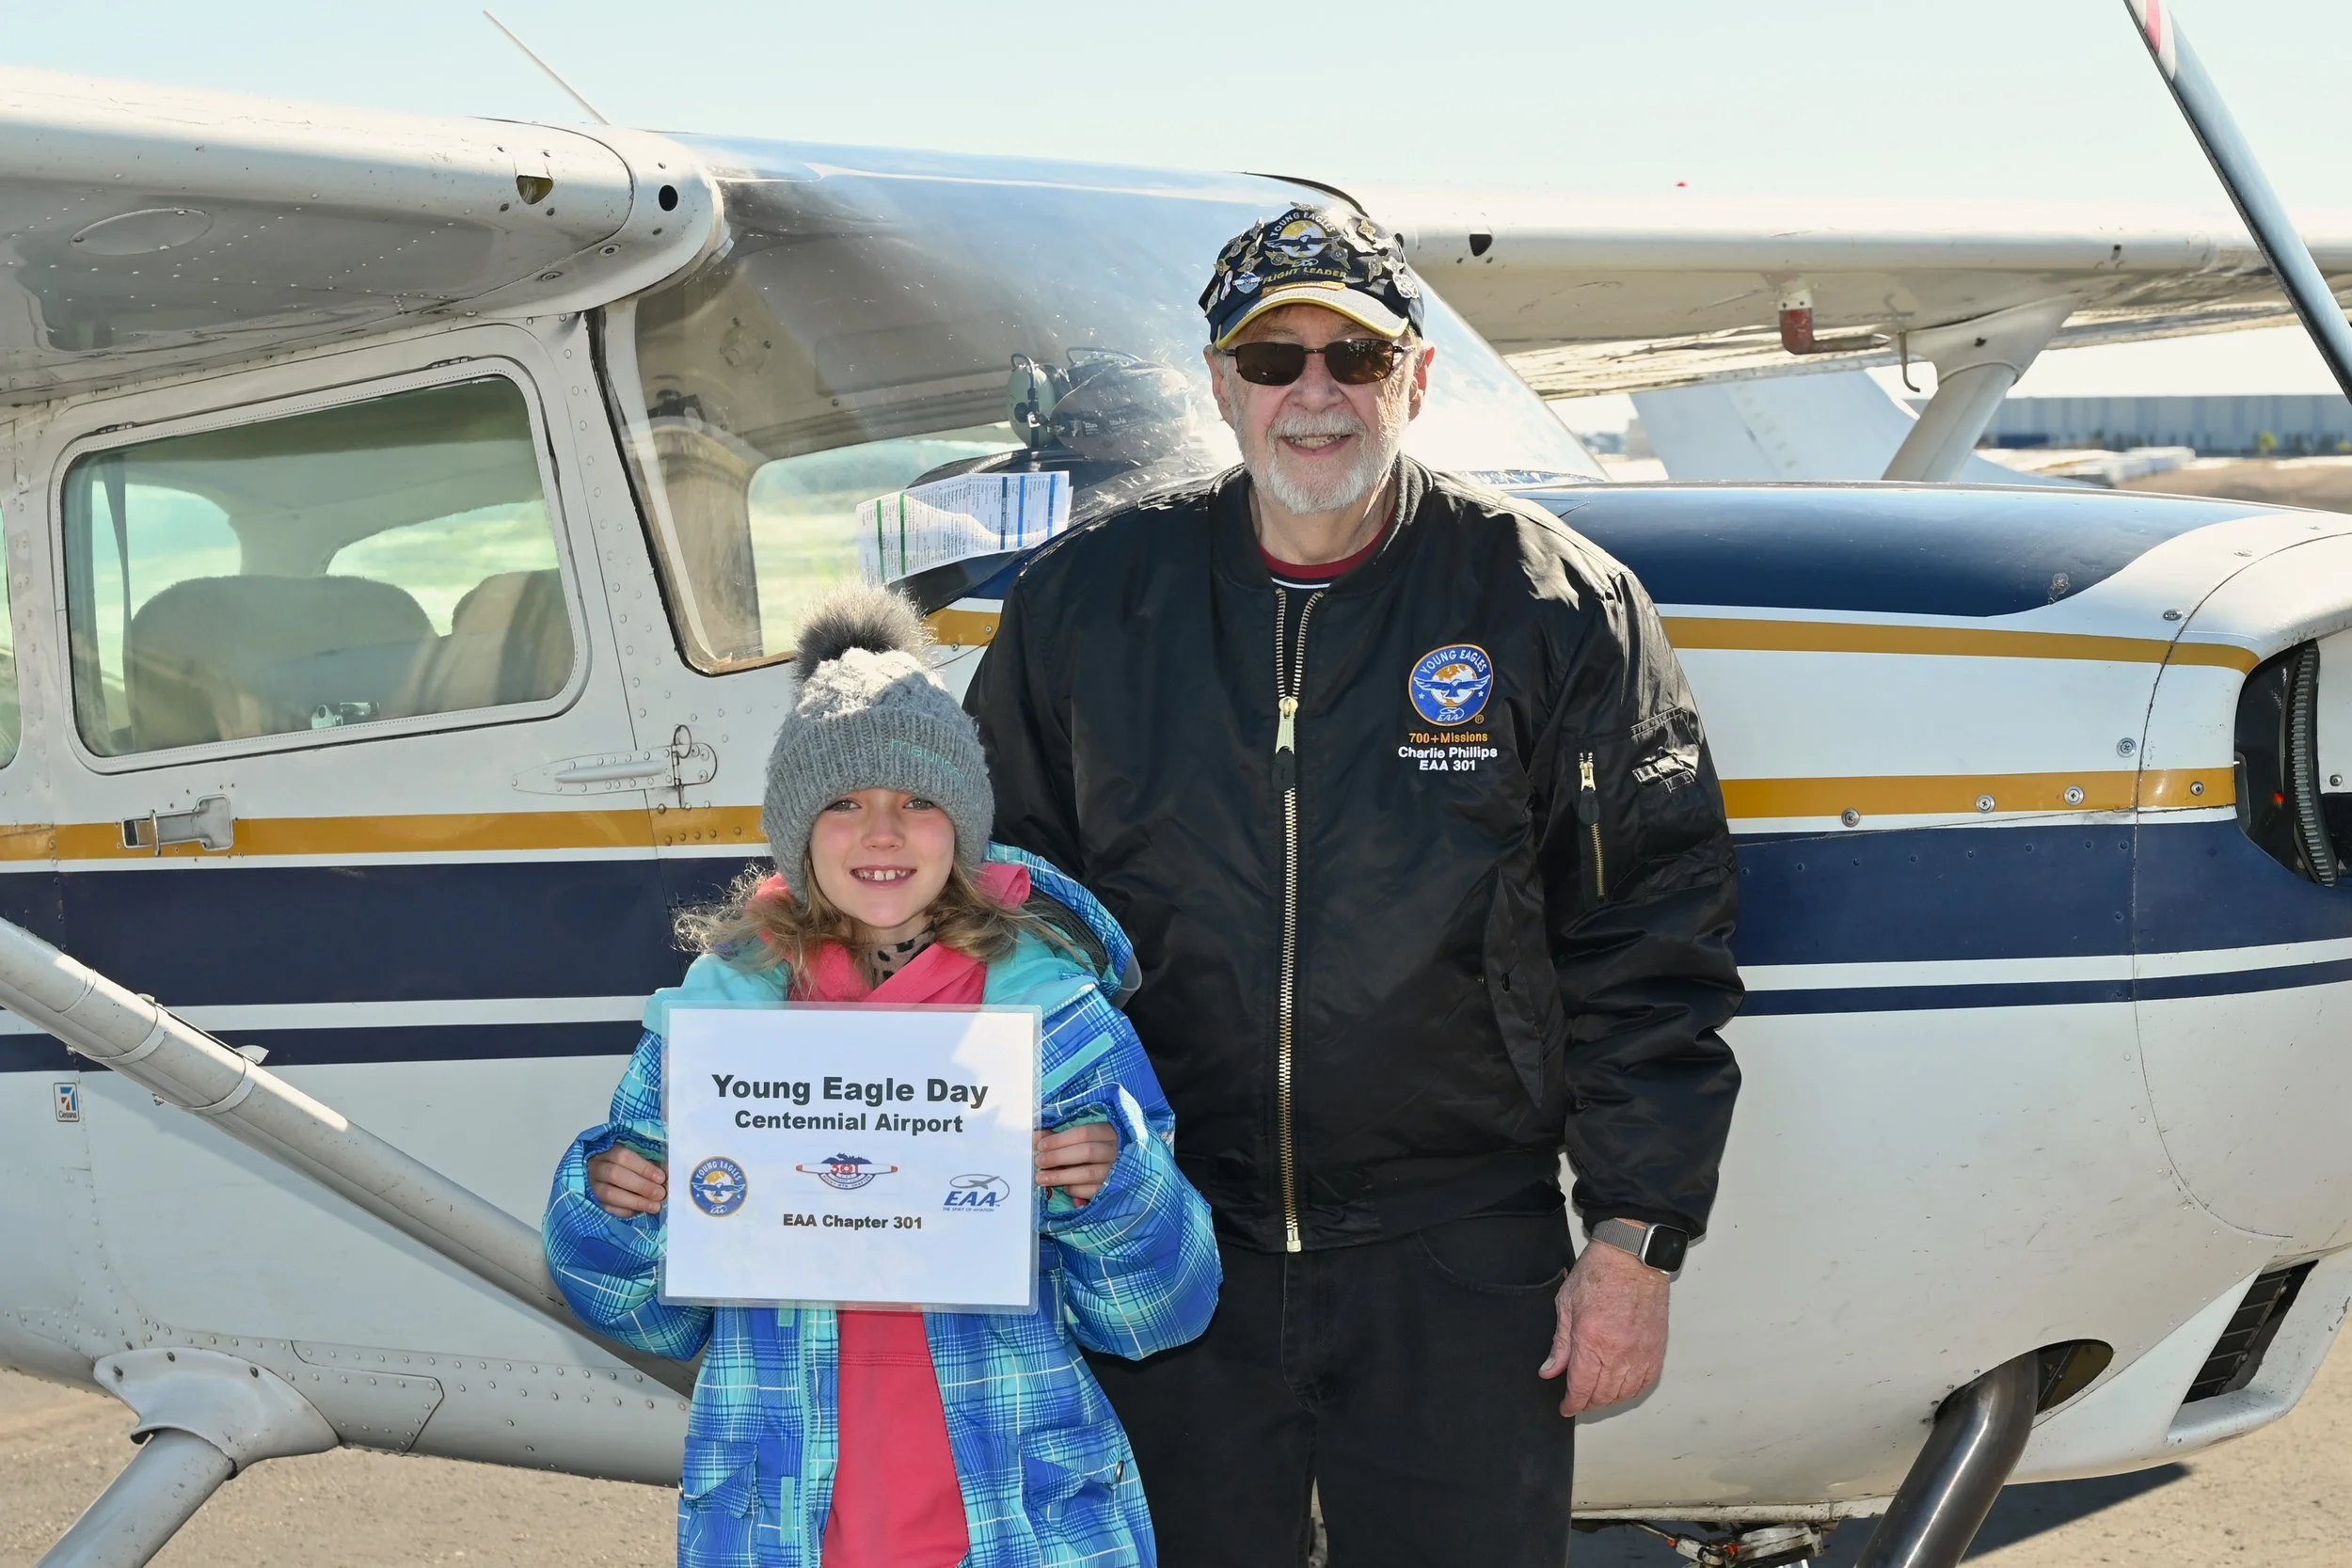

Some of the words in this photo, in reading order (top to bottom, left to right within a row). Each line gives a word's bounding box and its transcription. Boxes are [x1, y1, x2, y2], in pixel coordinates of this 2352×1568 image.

[1270, 212, 1300, 237] YOUNG
[1304, 212, 1336, 232] EAGLES
[1262, 268, 1299, 284] FLIGHT
[1303, 266, 1347, 279] LEADER
[1420, 650, 1457, 674] YOUNG
[1459, 649, 1487, 673] EAGLES
[1437, 713, 1460, 721] EAA
[1398, 746, 1446, 759] Charlie
[1449, 745, 1498, 760] Phillips
[1419, 759, 1449, 770] EAA
[1453, 759, 1476, 770] 301
[711, 1074, 810, 1106] Young
[823, 1076, 914, 1107] Eagle
[927, 1078, 989, 1109] Day
[735, 1110, 866, 1130] Centennial
[874, 1113, 963, 1136] Airport
[695, 1161, 718, 1180] YOUNG
[720, 1161, 742, 1180] EAGLES
[944, 1191, 997, 1207] EAA
[783, 1213, 818, 1227] EAA
[822, 1214, 889, 1230] Chapter
[893, 1216, 922, 1229] 301
